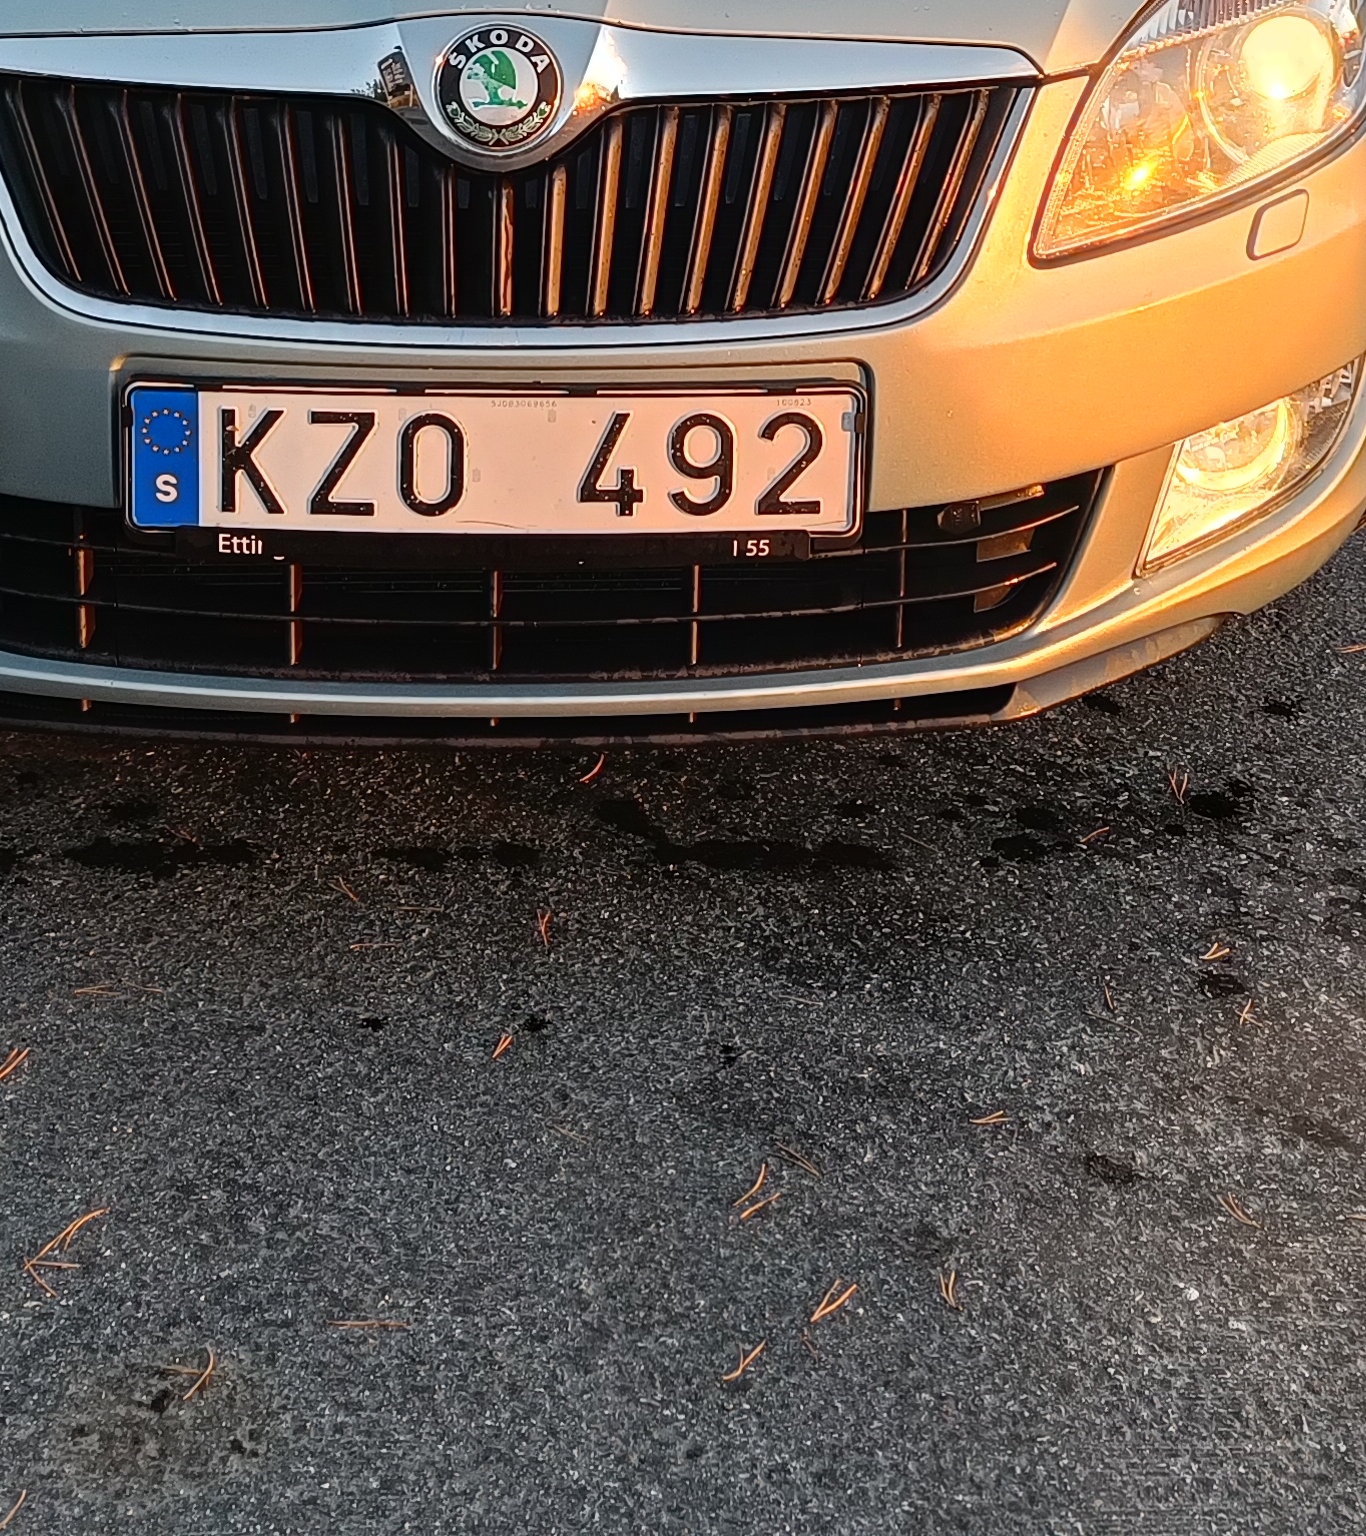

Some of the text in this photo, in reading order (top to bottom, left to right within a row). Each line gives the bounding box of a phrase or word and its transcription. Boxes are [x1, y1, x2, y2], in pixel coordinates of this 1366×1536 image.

[219, 407, 824, 517] KZO 492
[155, 473, 179, 503] S
[745, 539, 770, 557] 55
